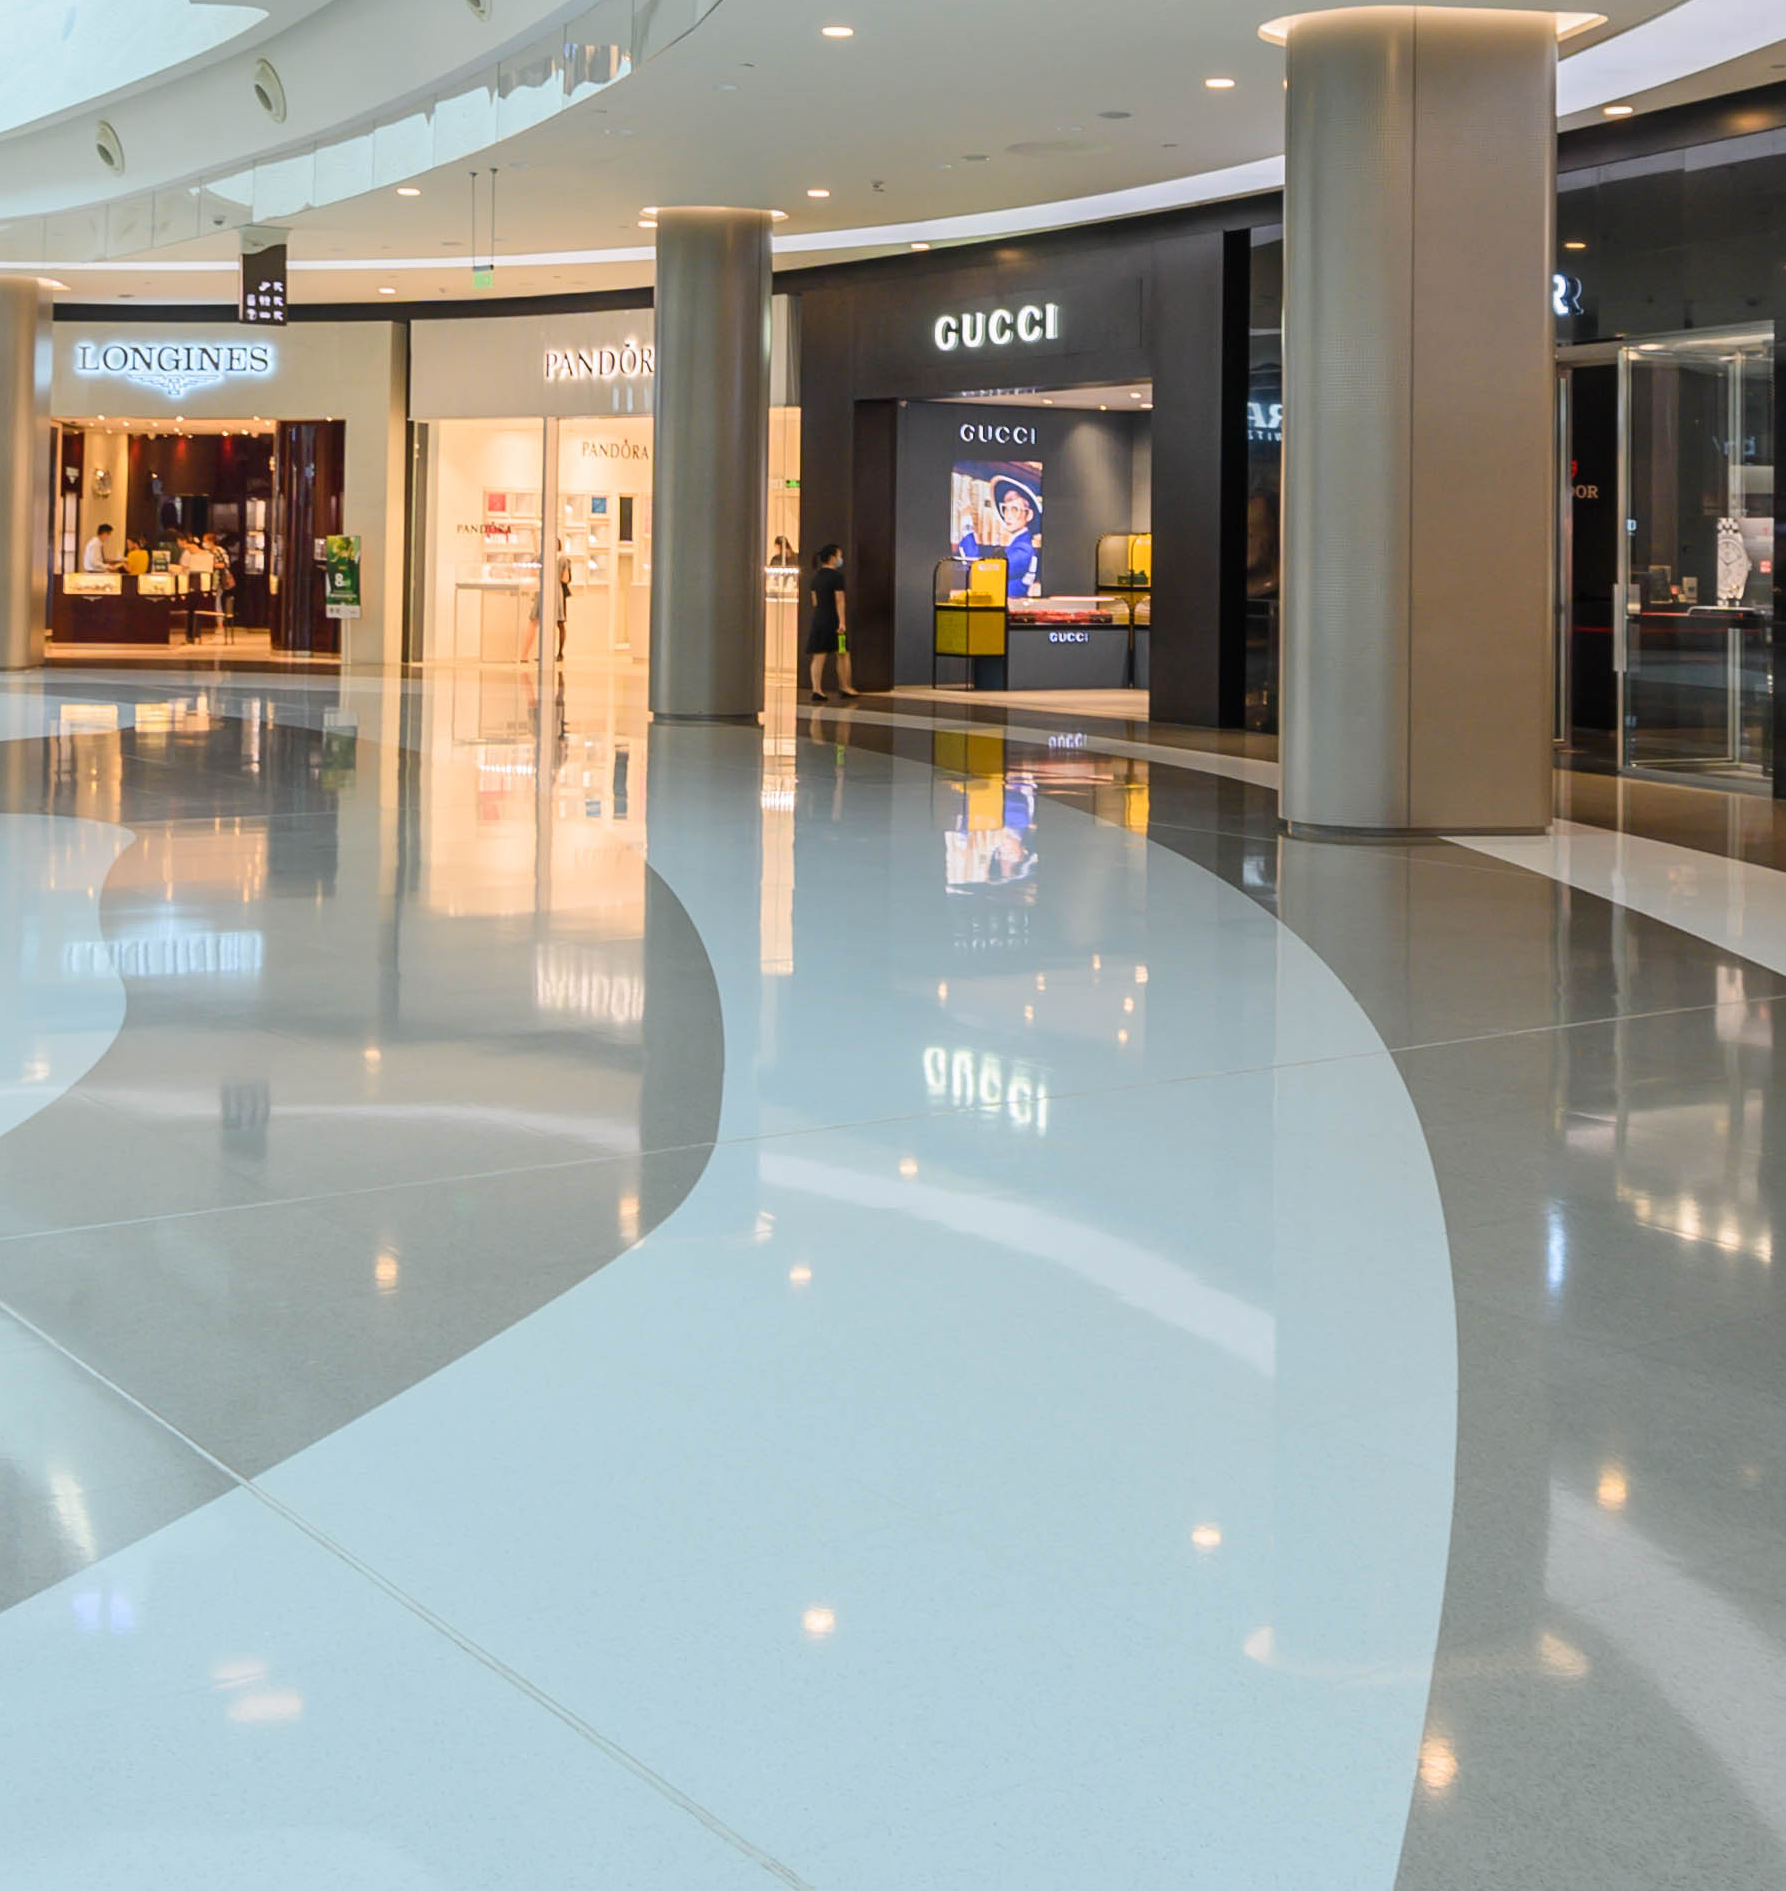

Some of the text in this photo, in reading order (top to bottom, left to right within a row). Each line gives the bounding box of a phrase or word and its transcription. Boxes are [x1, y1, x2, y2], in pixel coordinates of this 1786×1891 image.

[934, 303, 1059, 351] GUCCI
[78, 346, 269, 372] LONGINES
[959, 423, 1037, 445] GUCCI
[1049, 631, 1089, 643] GUCCI
